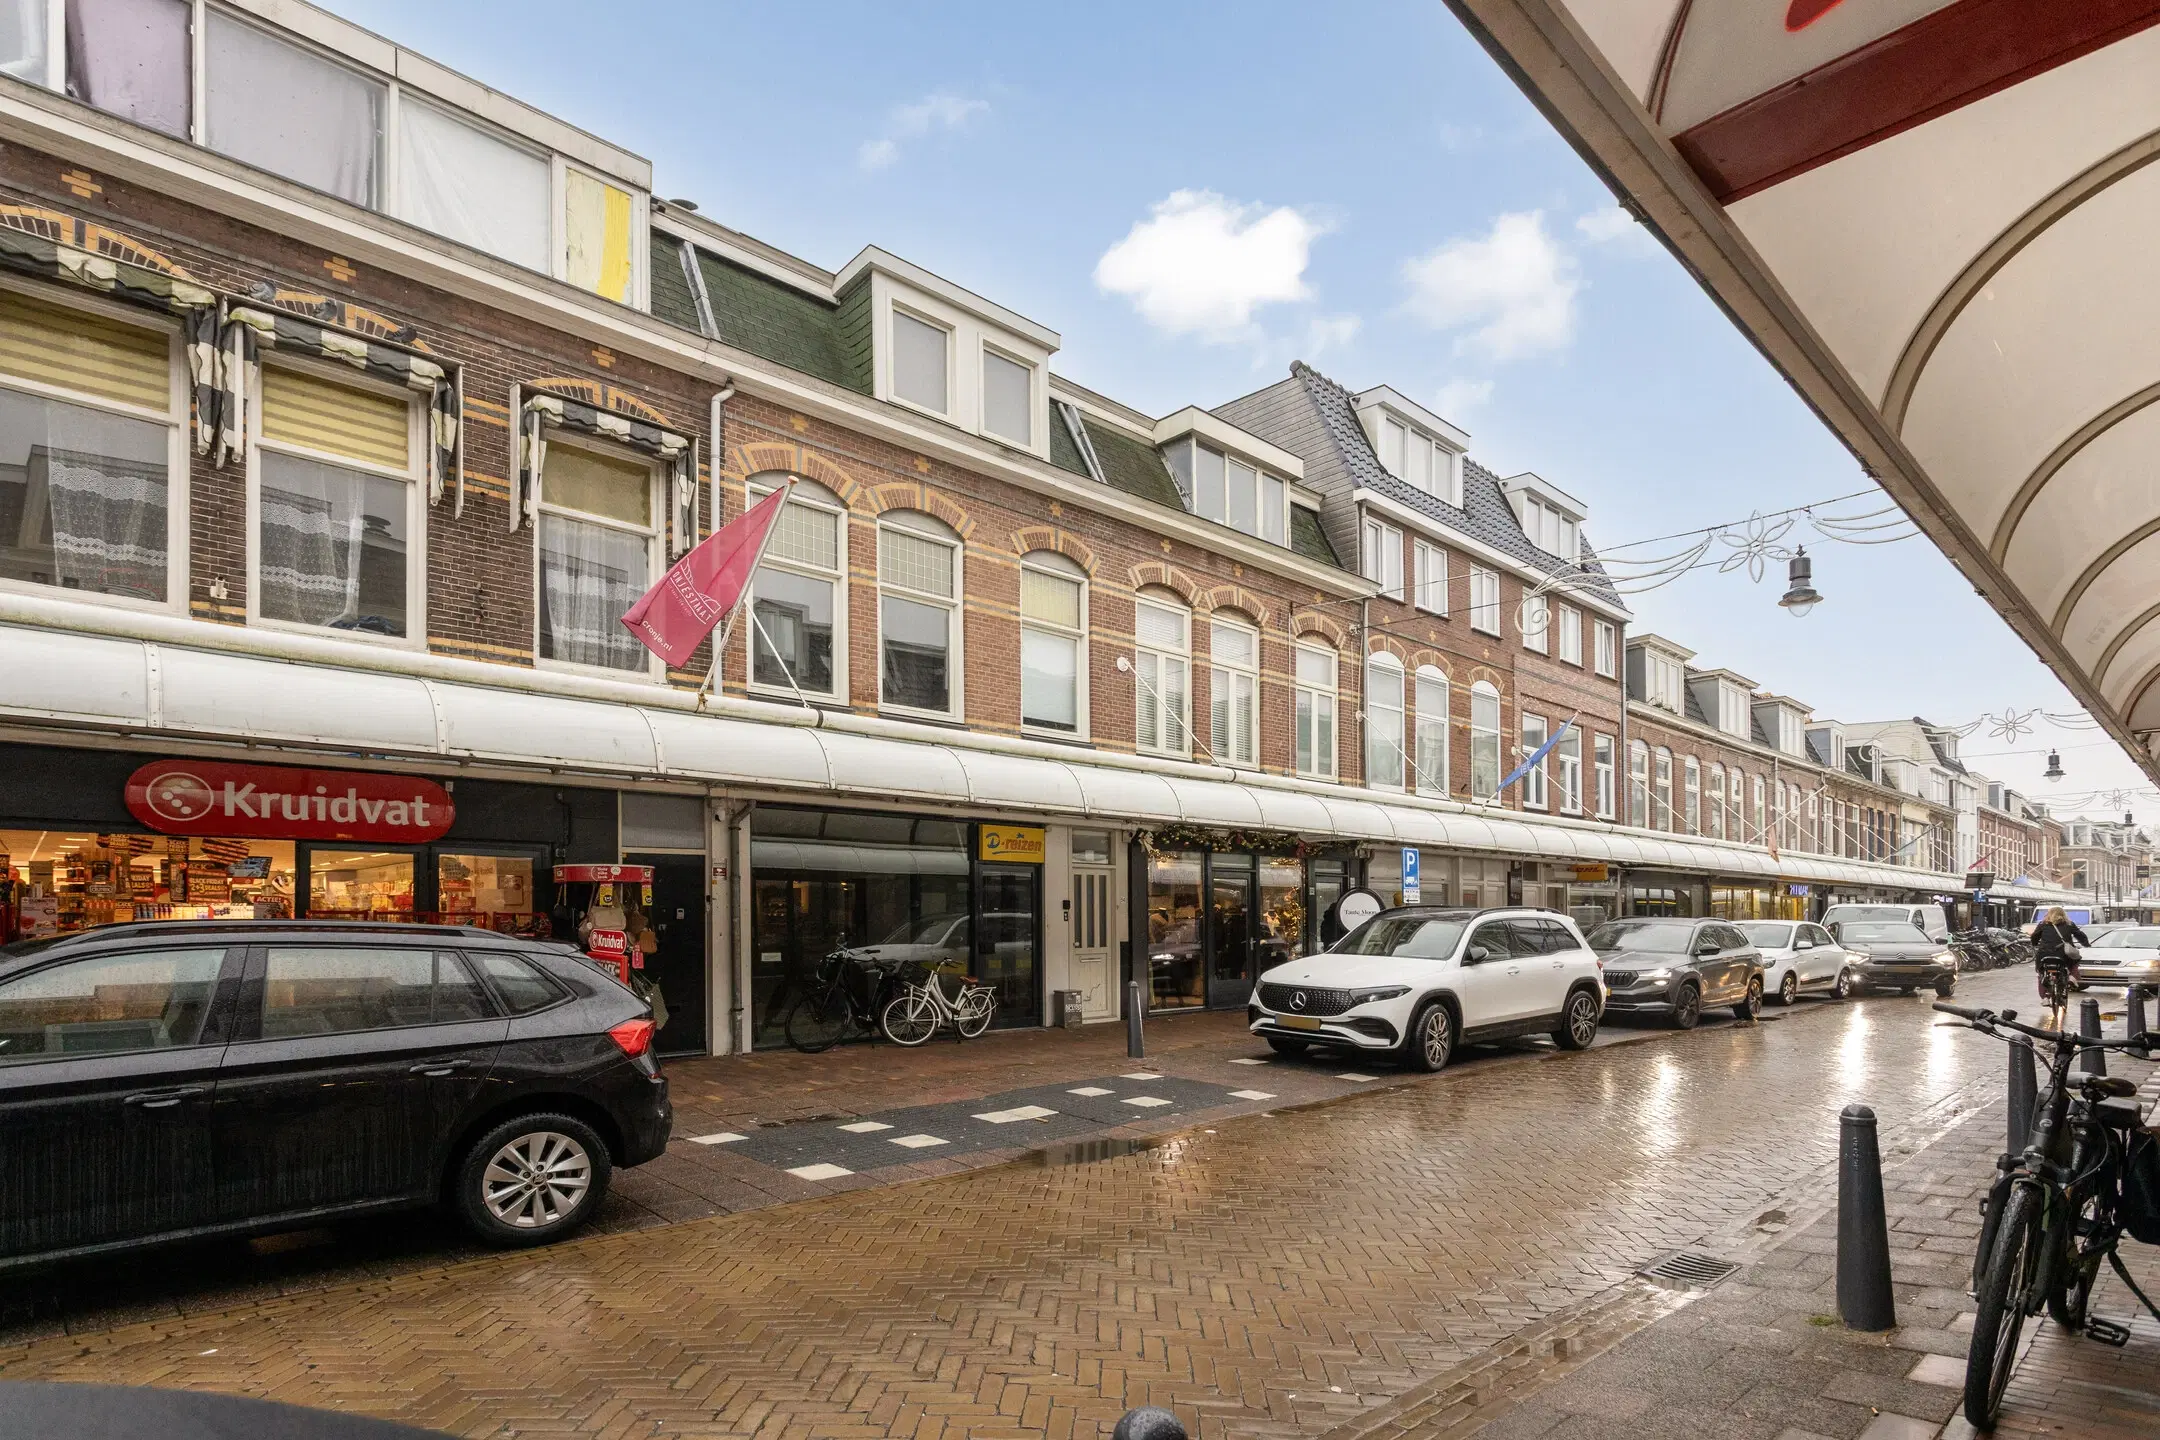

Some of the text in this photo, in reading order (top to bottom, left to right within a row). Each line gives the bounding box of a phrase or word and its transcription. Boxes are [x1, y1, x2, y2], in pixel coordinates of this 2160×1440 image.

[223, 781, 431, 827] Kruidvat
[1406, 852, 1416, 872] P
[597, 934, 624, 950] Kruidvat
